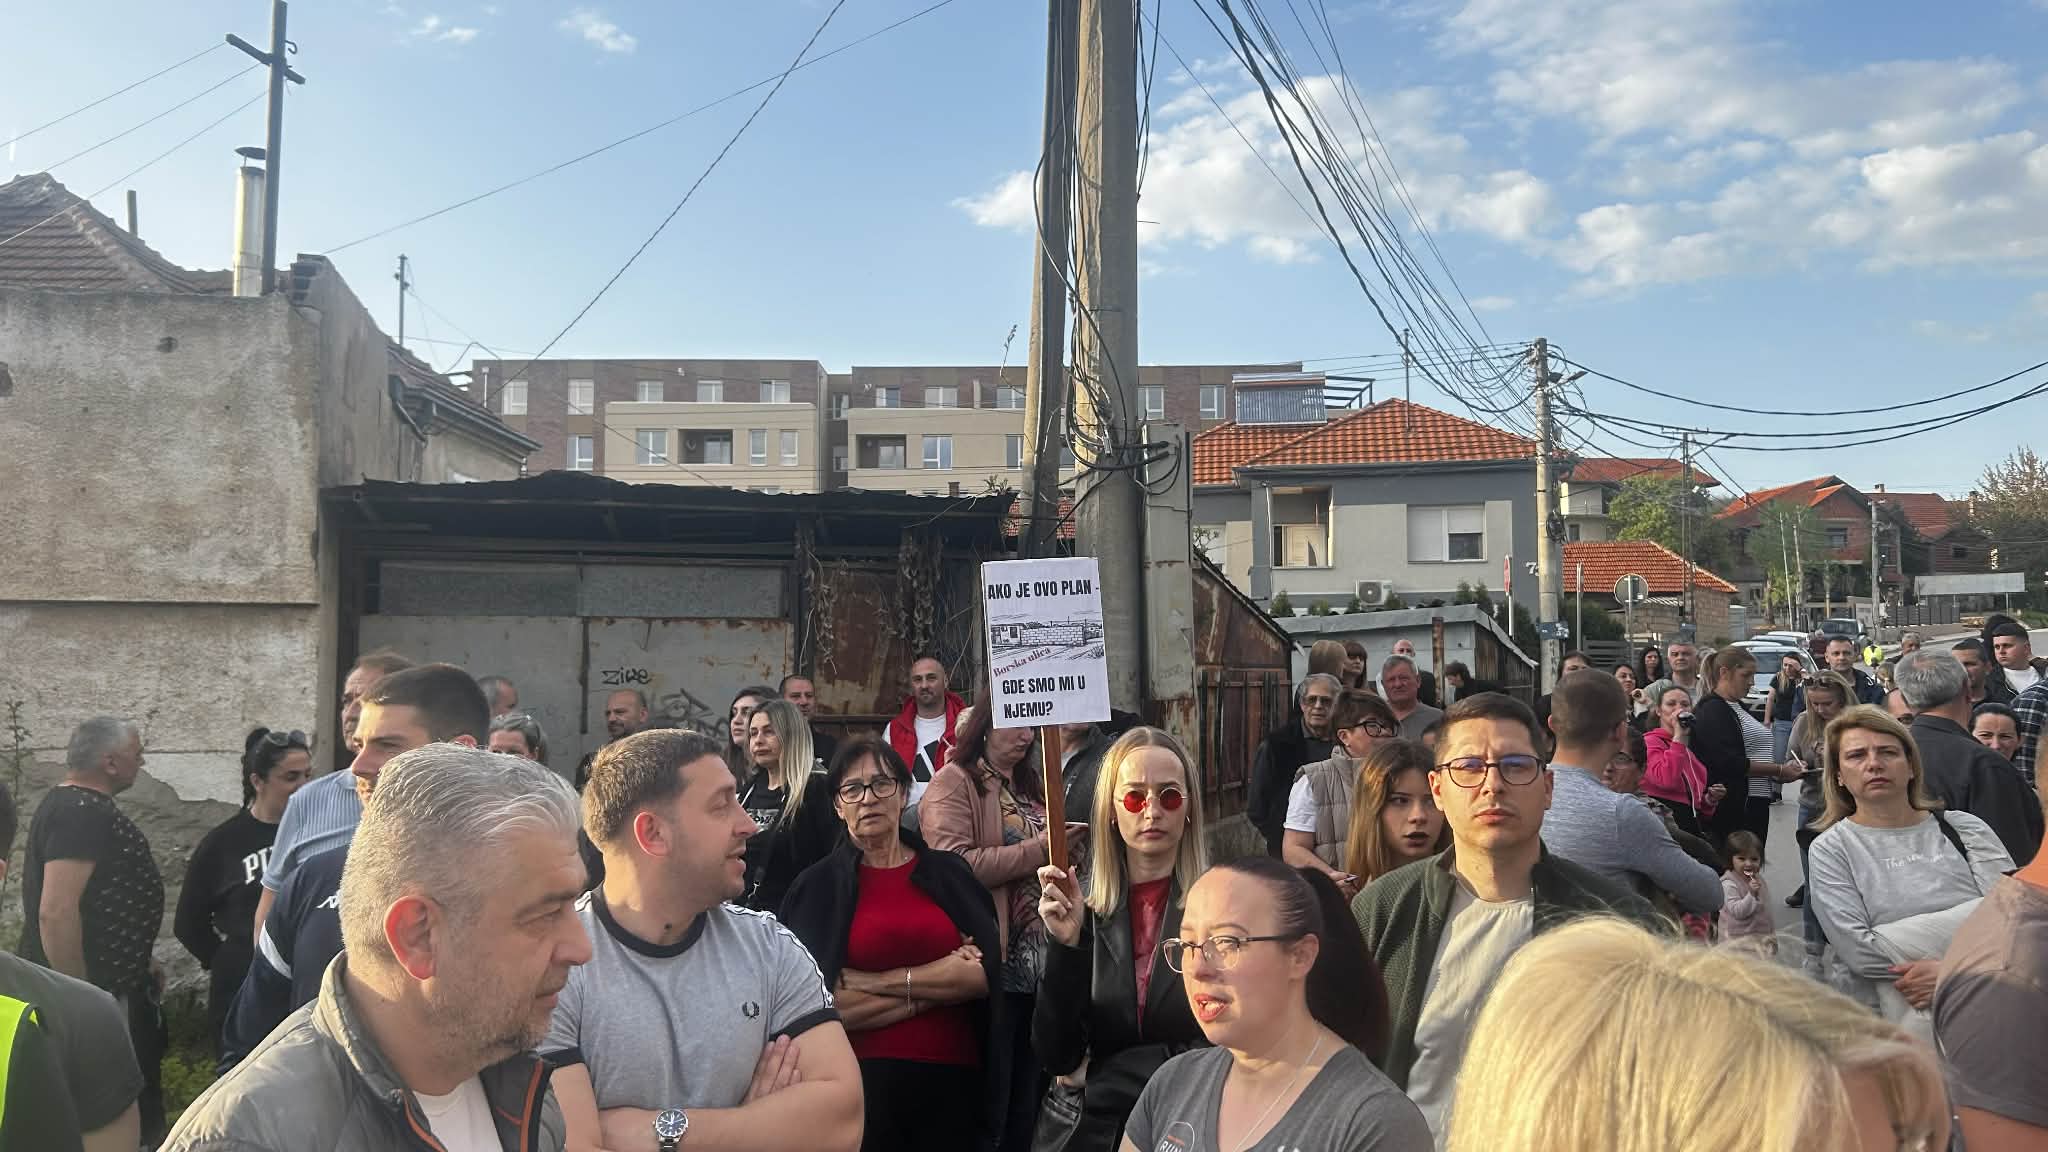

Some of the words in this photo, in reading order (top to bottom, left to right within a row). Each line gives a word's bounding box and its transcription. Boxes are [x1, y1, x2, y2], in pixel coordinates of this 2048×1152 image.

[988, 583, 1011, 600] AKO
[1015, 582, 1031, 598] JE
[1034, 580, 1058, 597] OVO
[1061, 579, 1092, 596] PLAN
[993, 657, 1029, 678] Borska
[1027, 647, 1051, 663] ulica
[1002, 679, 1025, 695] GDE
[1028, 677, 1055, 693] SMO
[1059, 677, 1074, 692] MI
[1077, 675, 1086, 690] U
[1003, 701, 1053, 719] NJEMU?
